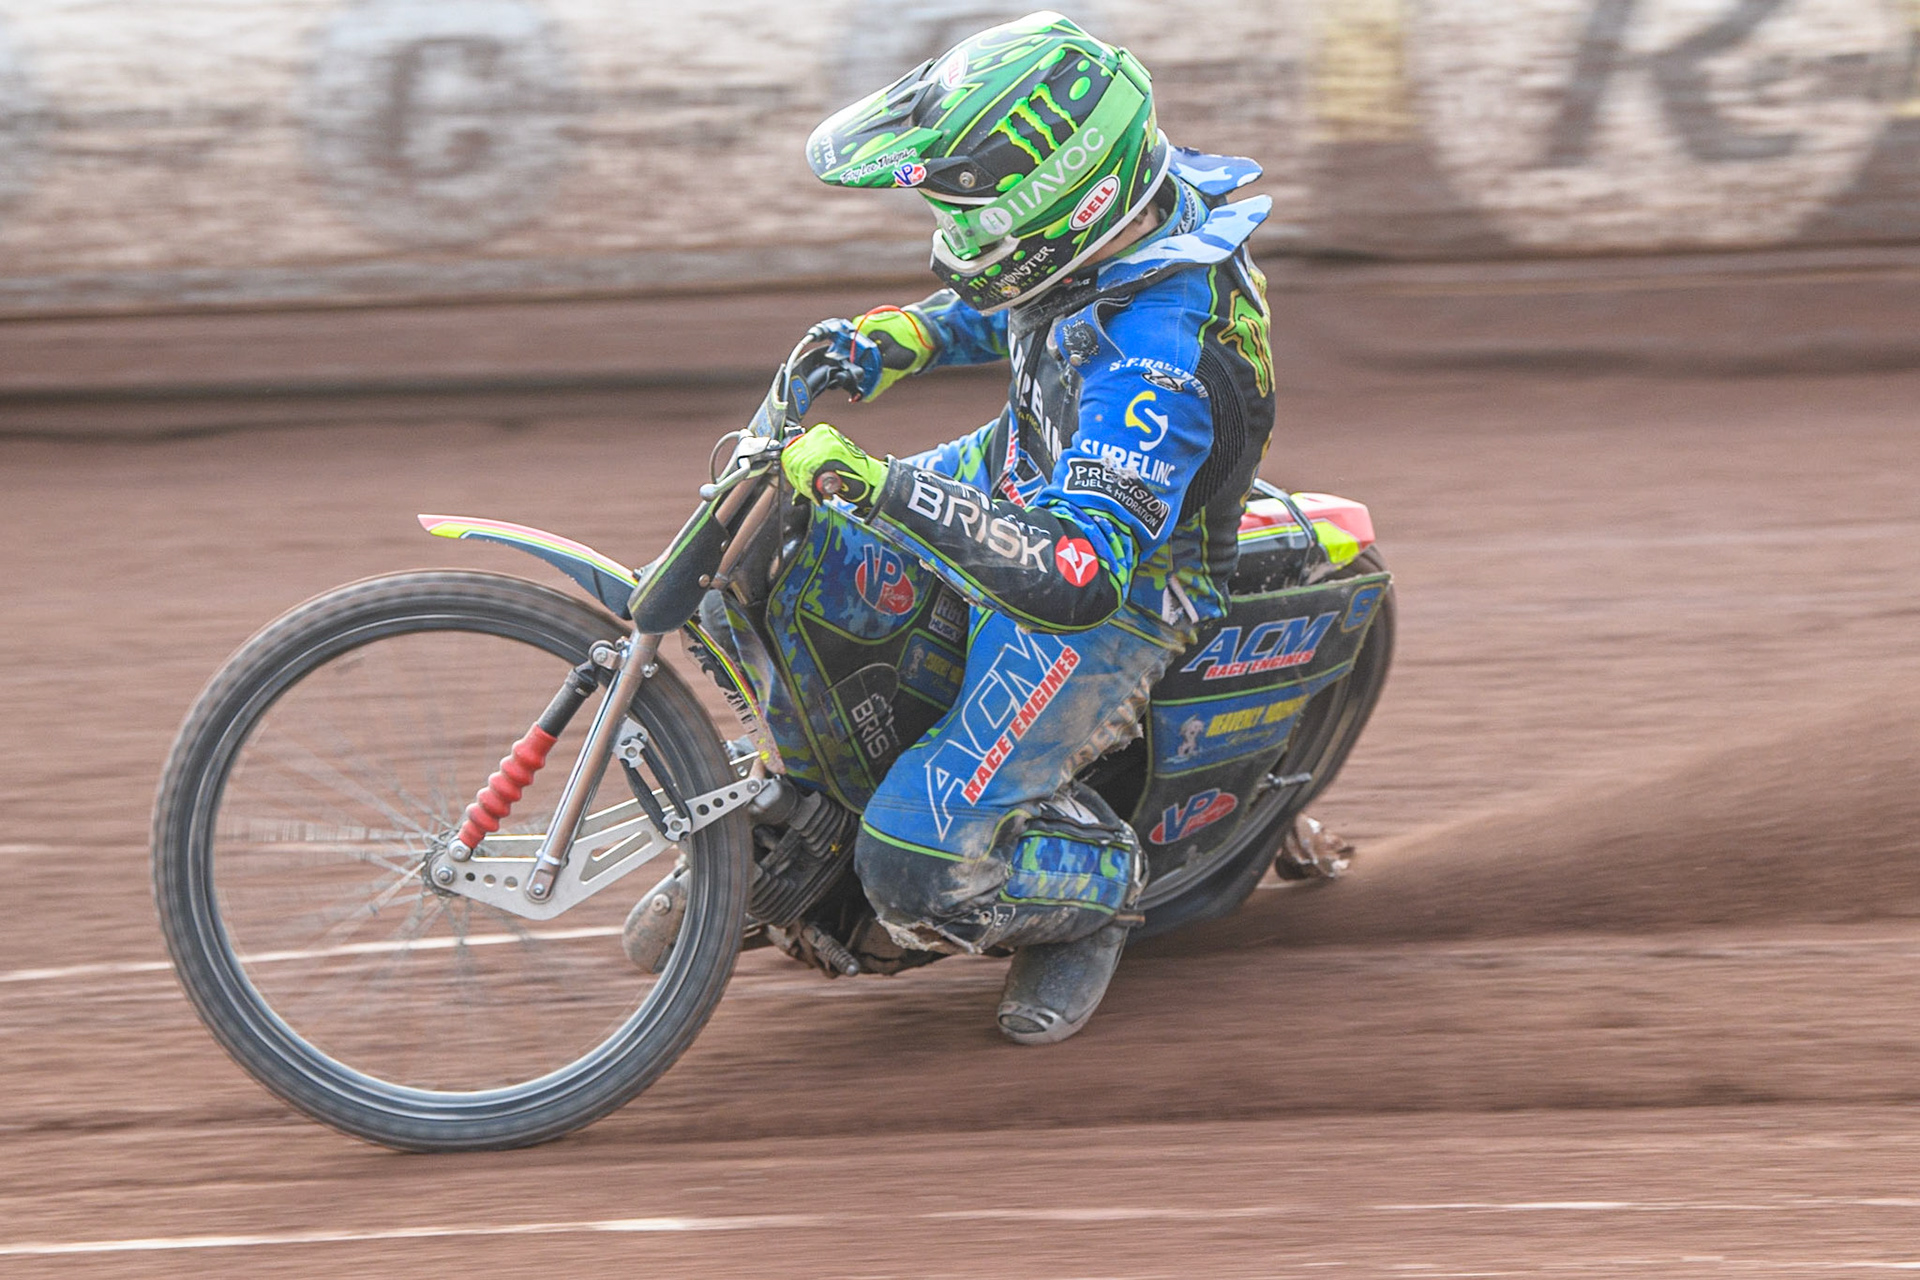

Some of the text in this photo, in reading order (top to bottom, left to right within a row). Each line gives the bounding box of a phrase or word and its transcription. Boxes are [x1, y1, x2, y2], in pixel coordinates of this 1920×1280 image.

[894, 163, 913, 186] VP
[1076, 186, 1115, 224] BELL
[1074, 478, 1104, 489] FUEL
[1113, 488, 1159, 528] HYDRATION
[1075, 465, 1168, 519] PRECISION
[907, 478, 1051, 573] BRISK
[863, 543, 904, 609] VP
[1180, 611, 1341, 673] ACM
[1203, 650, 1314, 681] RACE ENGINES
[923, 623, 1067, 843] ACM
[961, 645, 1081, 807] RACE ENGINES
[1163, 788, 1221, 842] VP
